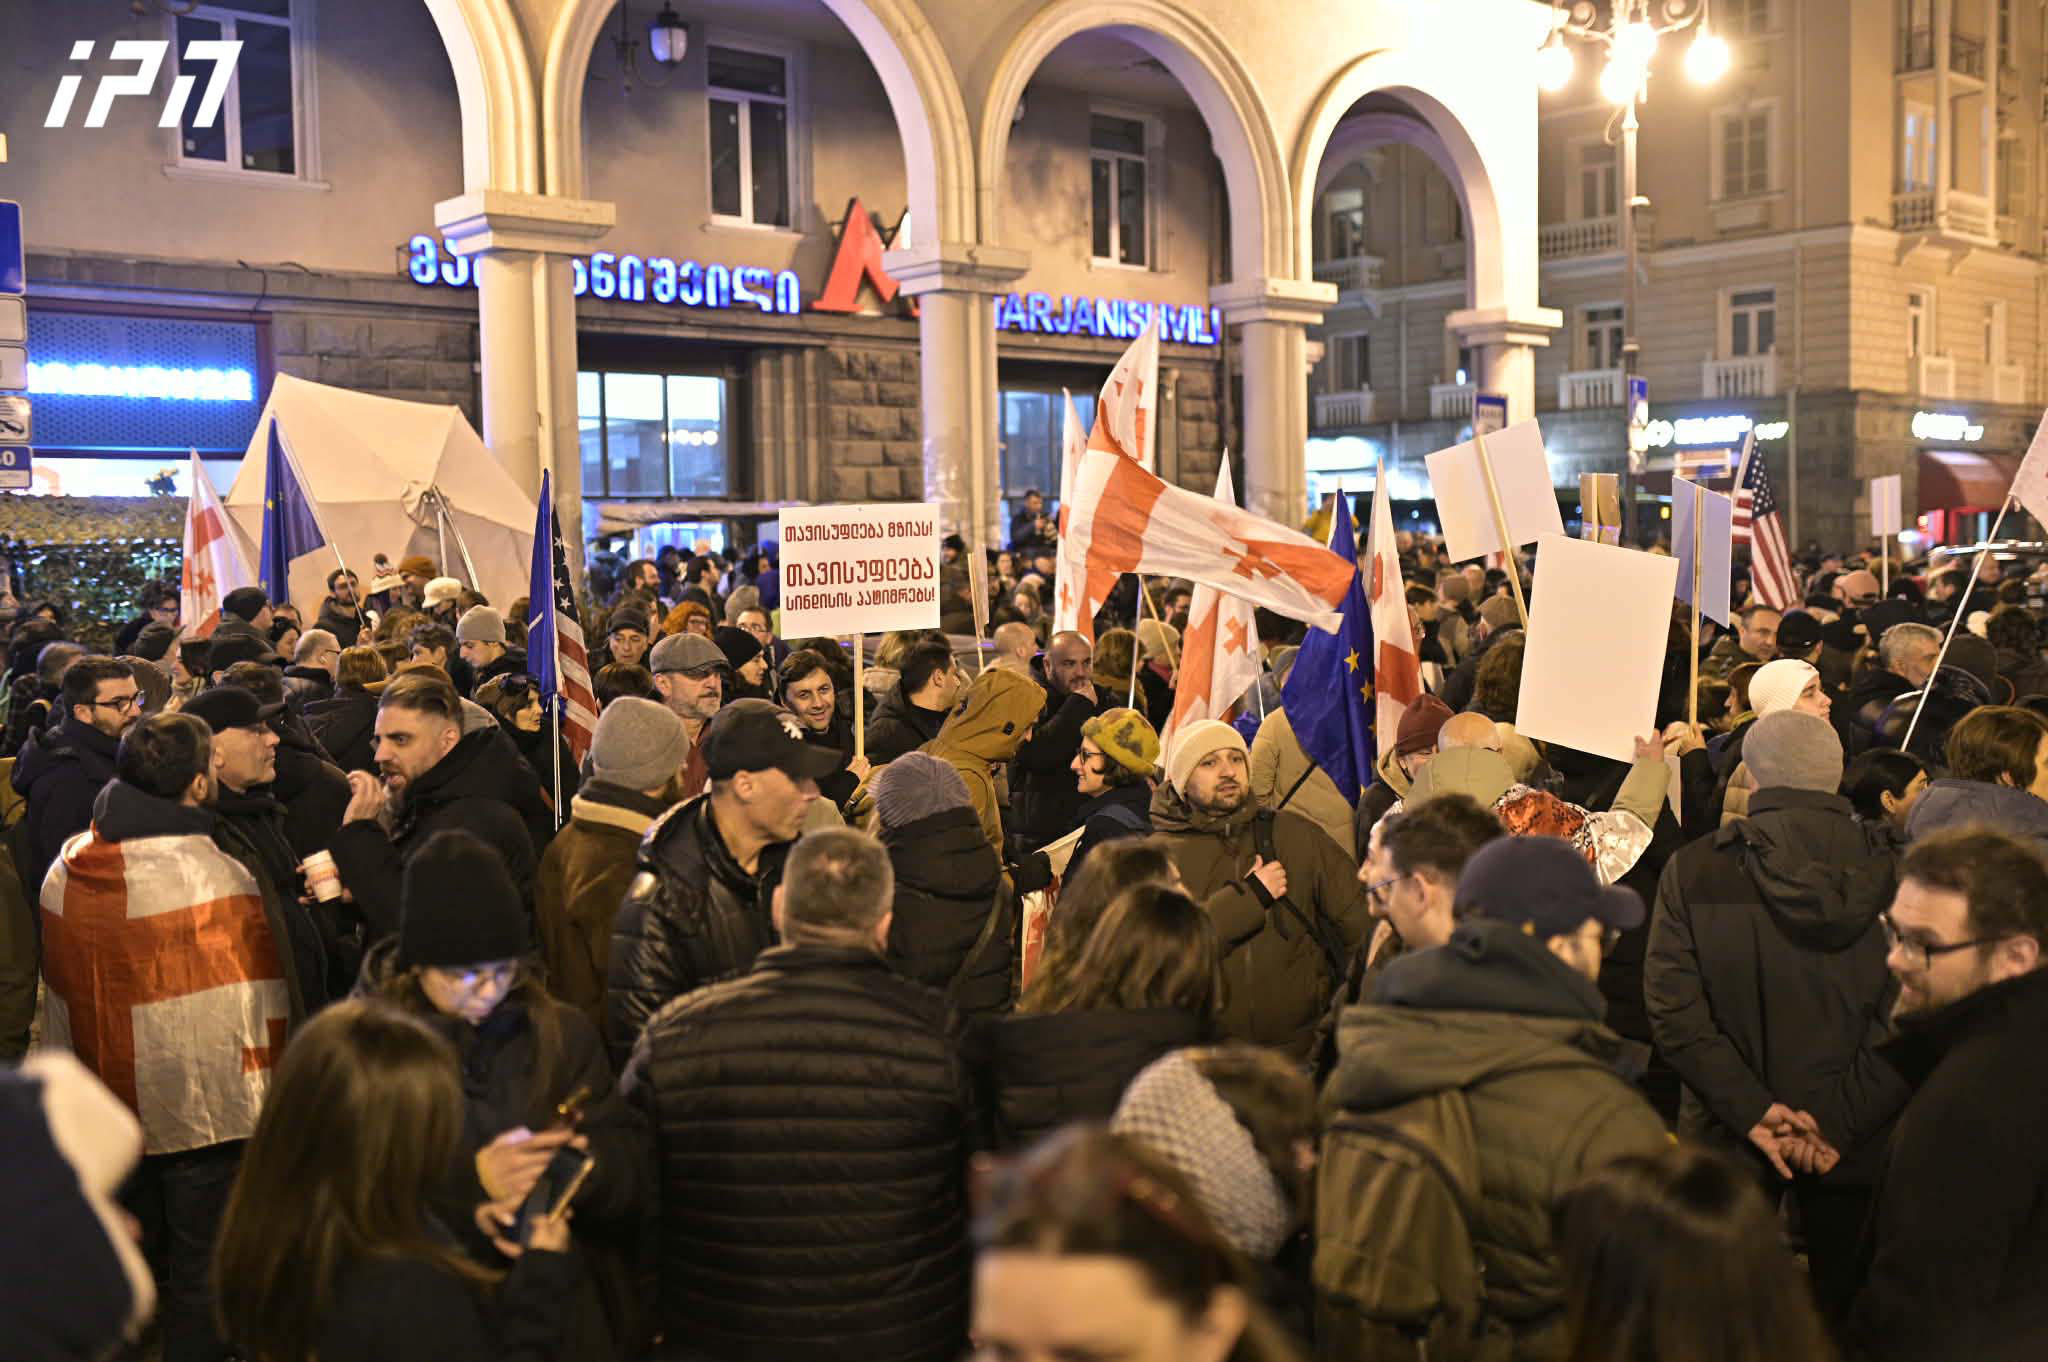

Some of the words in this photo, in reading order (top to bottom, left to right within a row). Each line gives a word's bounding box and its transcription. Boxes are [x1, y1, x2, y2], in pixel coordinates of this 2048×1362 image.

[408, 234, 801, 315] მანიშვილი
[785, 523, 883, 542] თავისუფლება
[888, 521, 933, 537] მზიას!
[786, 557, 934, 587] თავისუფლება
[786, 592, 852, 611] სინდისის
[857, 588, 935, 606] პატიმრებს!
